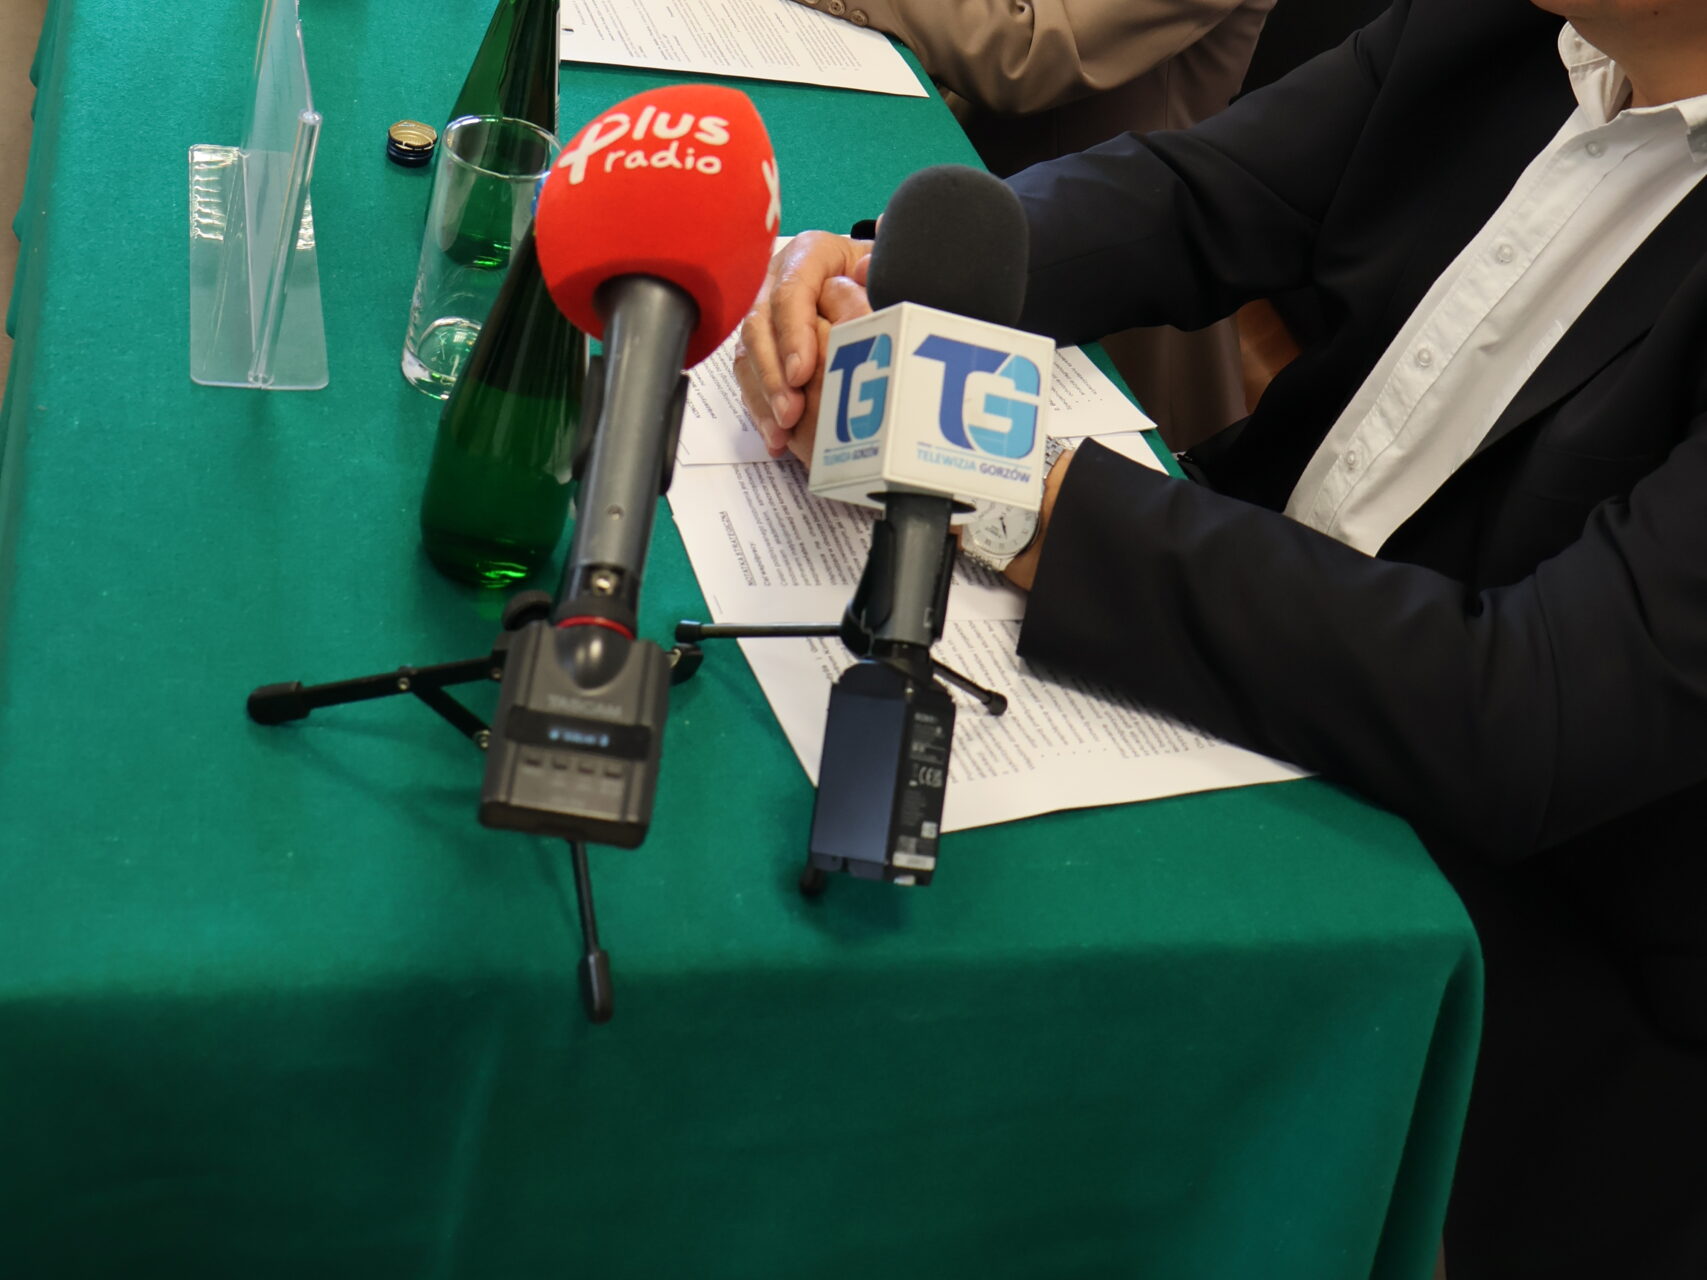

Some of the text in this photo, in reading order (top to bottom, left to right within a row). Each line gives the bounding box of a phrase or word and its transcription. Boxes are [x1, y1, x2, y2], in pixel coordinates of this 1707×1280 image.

[604, 140, 722, 175] radio
[912, 334, 1041, 459] TG
[917, 448, 1032, 484] TELEWIZJA GORZÓW
